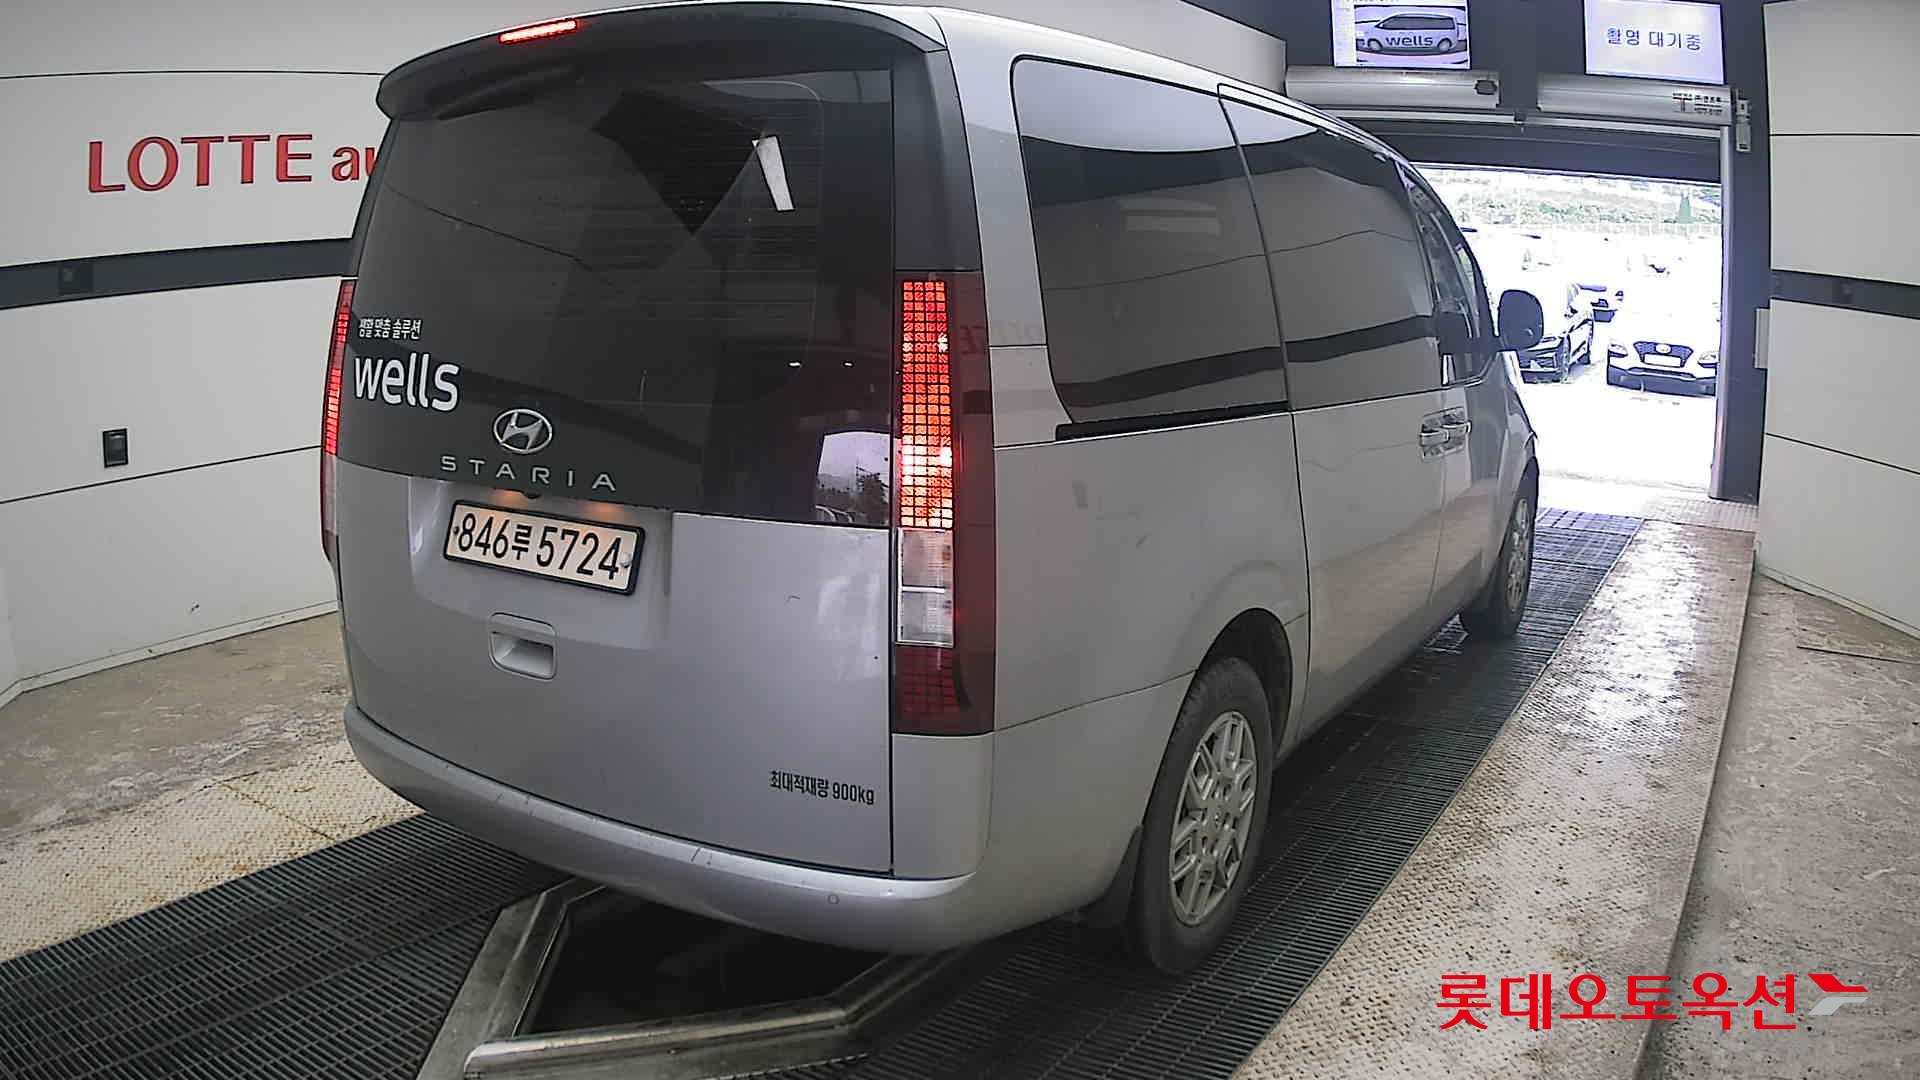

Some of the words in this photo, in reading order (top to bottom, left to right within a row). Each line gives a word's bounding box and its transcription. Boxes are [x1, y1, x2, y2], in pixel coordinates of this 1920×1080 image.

[1386, 35, 1433, 47] wells
[1649, 31, 1701, 51] 대기중
[88, 134, 313, 193] LOTTE
[392, 319, 422, 340] 솔루션
[354, 352, 460, 412] wells
[441, 455, 617, 492] STARIA
[770, 770, 829, 798] 최대적재량
[832, 781, 875, 805] 900kg
